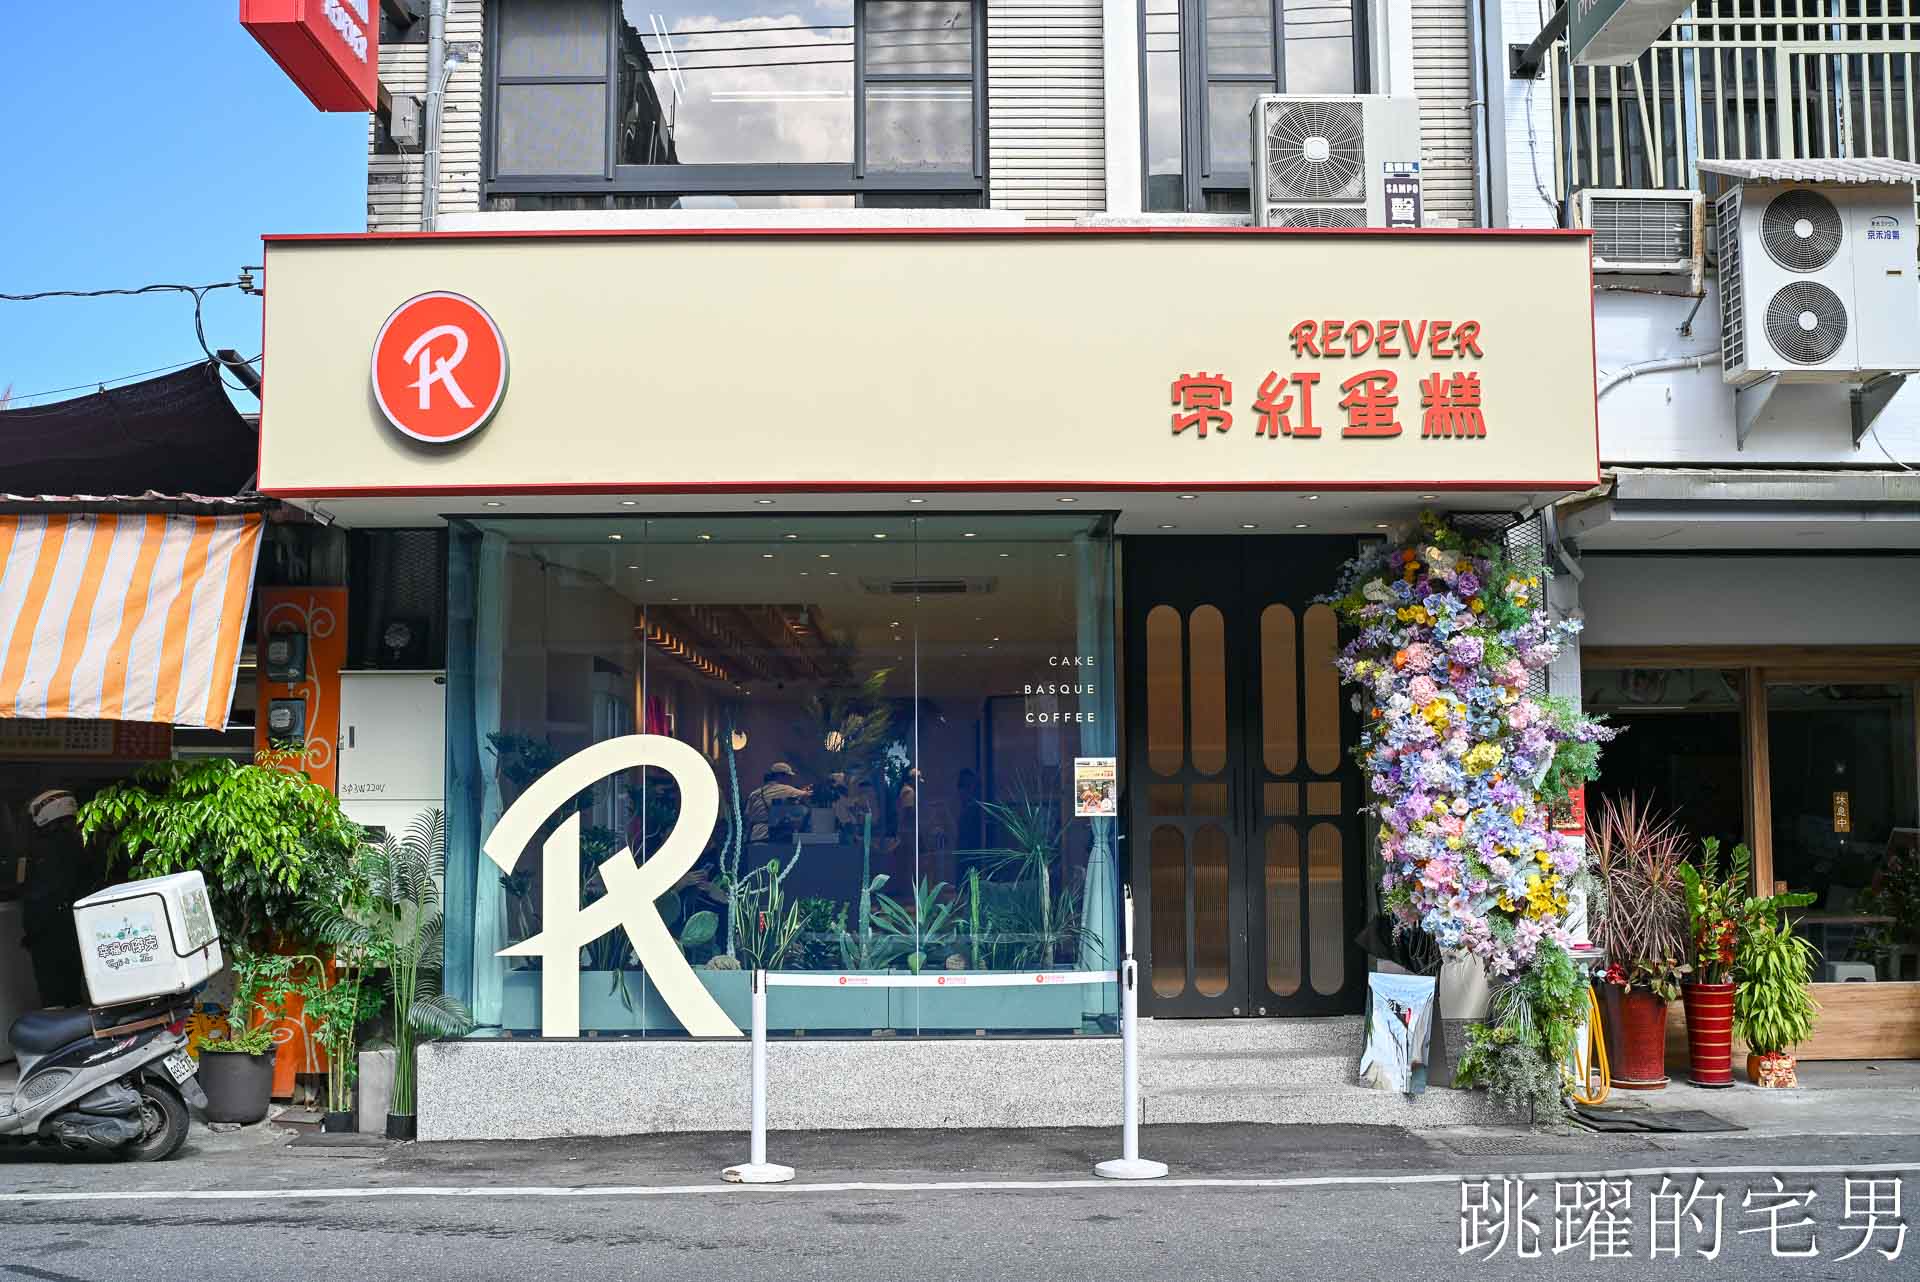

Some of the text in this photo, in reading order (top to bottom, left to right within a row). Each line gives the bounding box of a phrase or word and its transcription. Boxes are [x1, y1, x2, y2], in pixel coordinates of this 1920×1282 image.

[1386, 183, 1419, 194] SAMPO
[1289, 319, 1484, 357] REDEVER
[1171, 370, 1487, 438] 常紅蛋糕
[1049, 655, 1095, 666] CAKE
[1024, 684, 1096, 695] BASQUE
[1025, 712, 1096, 723] COFFEE
[1835, 795, 1848, 829] 休息中
[483, 734, 745, 1037] R
